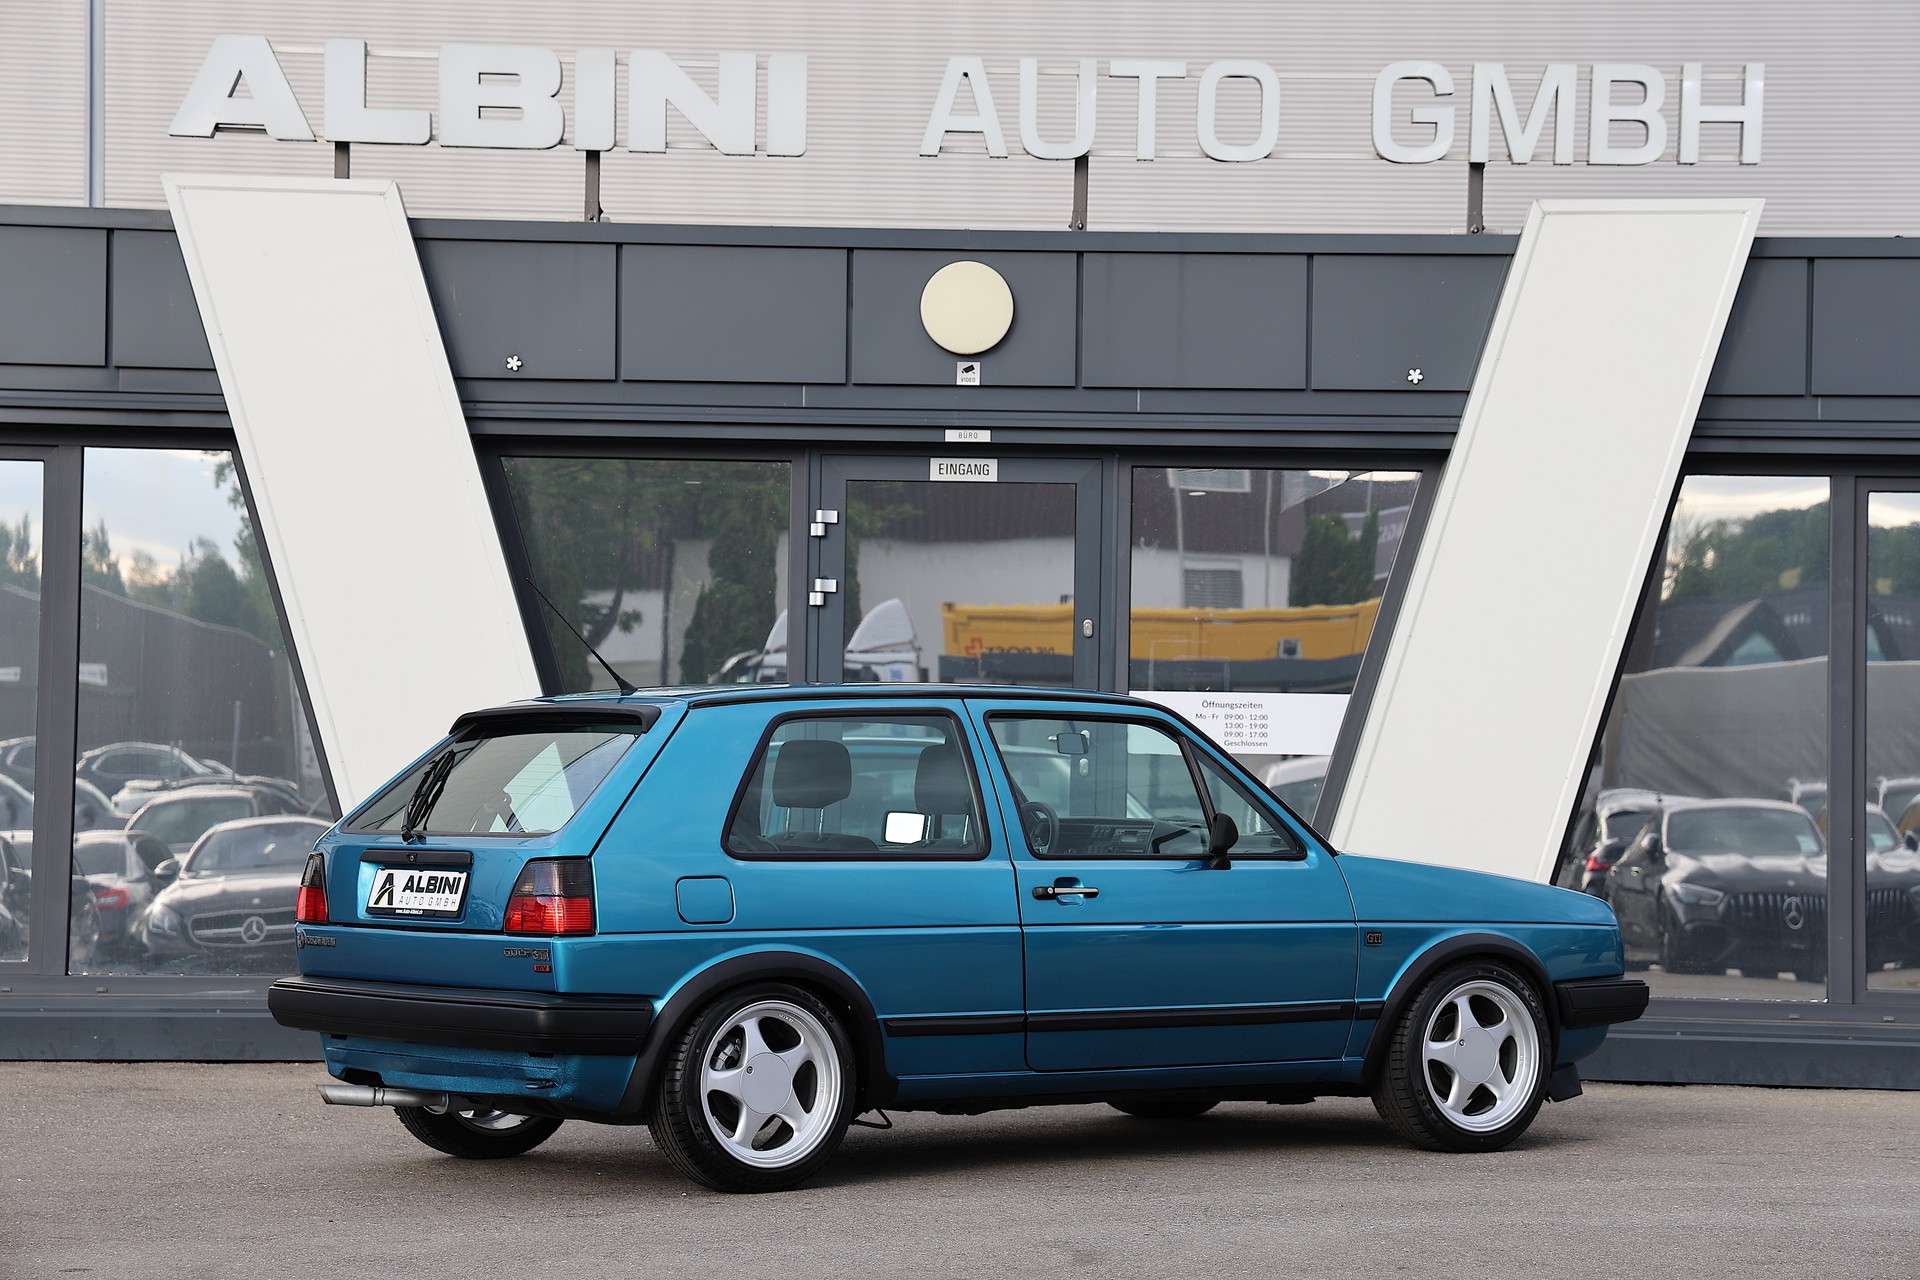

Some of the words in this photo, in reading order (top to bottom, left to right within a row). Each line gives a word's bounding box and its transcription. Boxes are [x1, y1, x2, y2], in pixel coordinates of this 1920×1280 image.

[167, 34, 808, 157] ALBINI
[919, 57, 1281, 162] AUTO
[1371, 60, 1764, 166] GMBH
[958, 431, 978, 439] BÜRO
[938, 463, 990, 476] EINGANG
[1201, 700, 1263, 710] Öffnungszeiten
[402, 875, 462, 895] ALBINI
[398, 896, 425, 906] AUTO
[428, 897, 457, 907] GMBH
[1367, 933, 1382, 943] GTI
